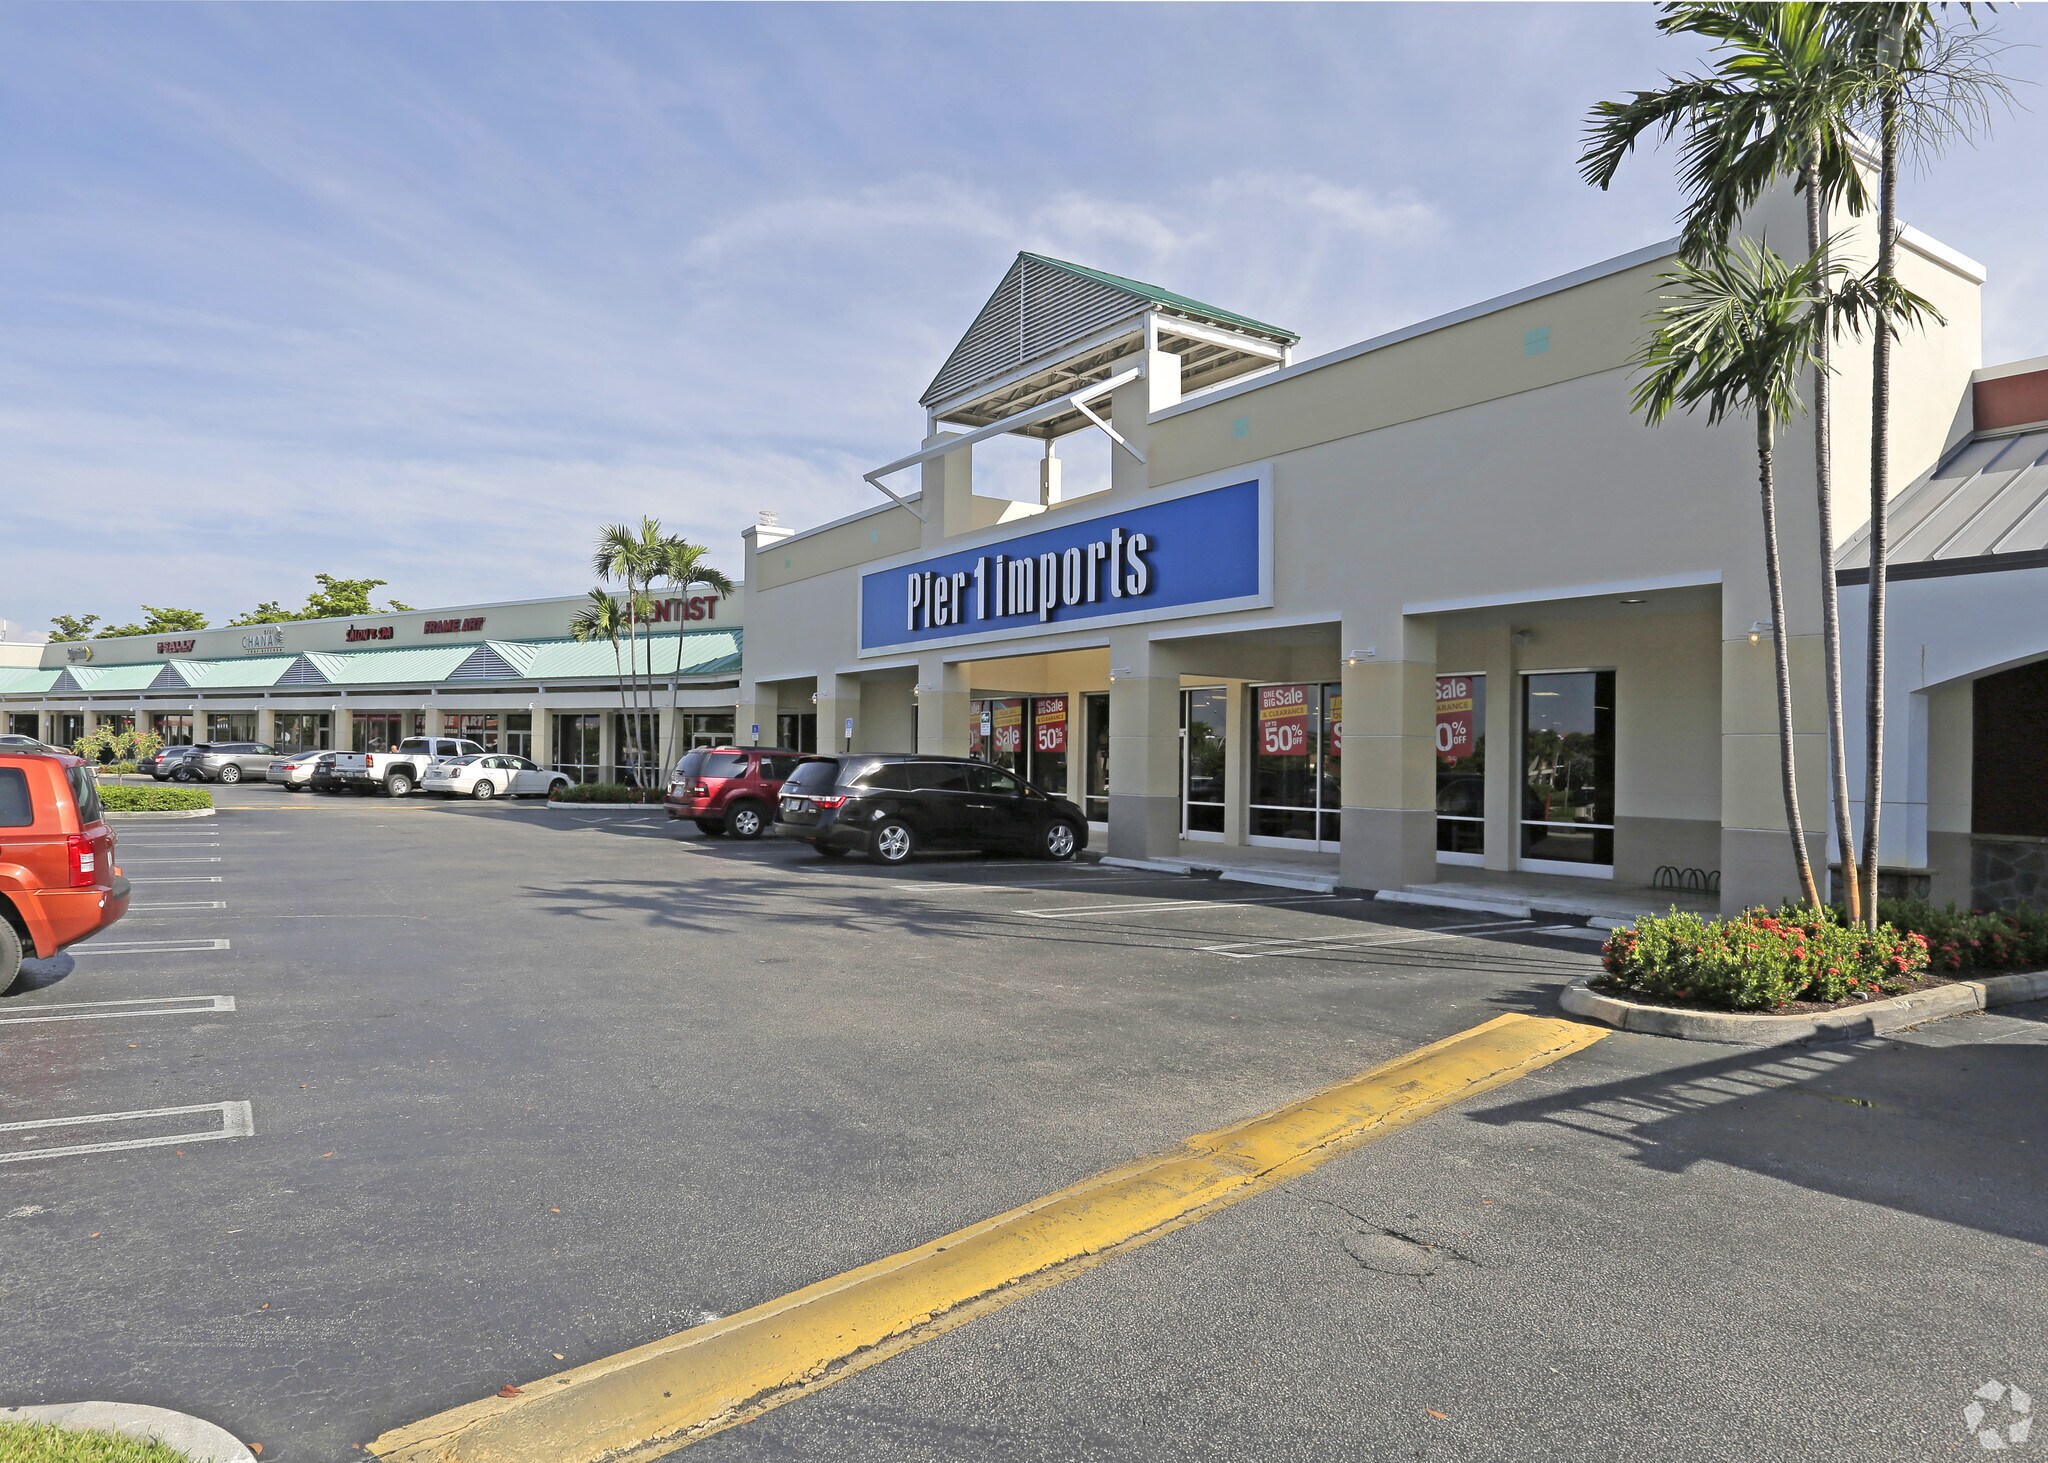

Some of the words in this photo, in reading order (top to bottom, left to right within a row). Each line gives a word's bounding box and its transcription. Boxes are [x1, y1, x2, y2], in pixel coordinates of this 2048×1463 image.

[908, 571, 966, 631] Pier
[974, 556, 985, 620] 1
[996, 527, 1148, 622] imports
[626, 596, 719, 624] NTIST
[424, 619, 460, 634] FRAME
[462, 616, 486, 631] ART
[162, 640, 194, 651] SALLY
[1263, 690, 1275, 698] ONE
[1436, 678, 1467, 700] Sale
[1264, 698, 1276, 708] BIG
[1275, 687, 1303, 706] Sale
[970, 703, 980, 715] ale
[1045, 699, 1063, 713] Sale
[1268, 707, 1304, 717] CLEARANCE
[1436, 702, 1468, 711] ARANCE
[995, 725, 1020, 747] Sale
[1292, 737, 1303, 745] OFF
[1436, 721, 1467, 752] 0%
[1453, 736, 1467, 745] OFF
